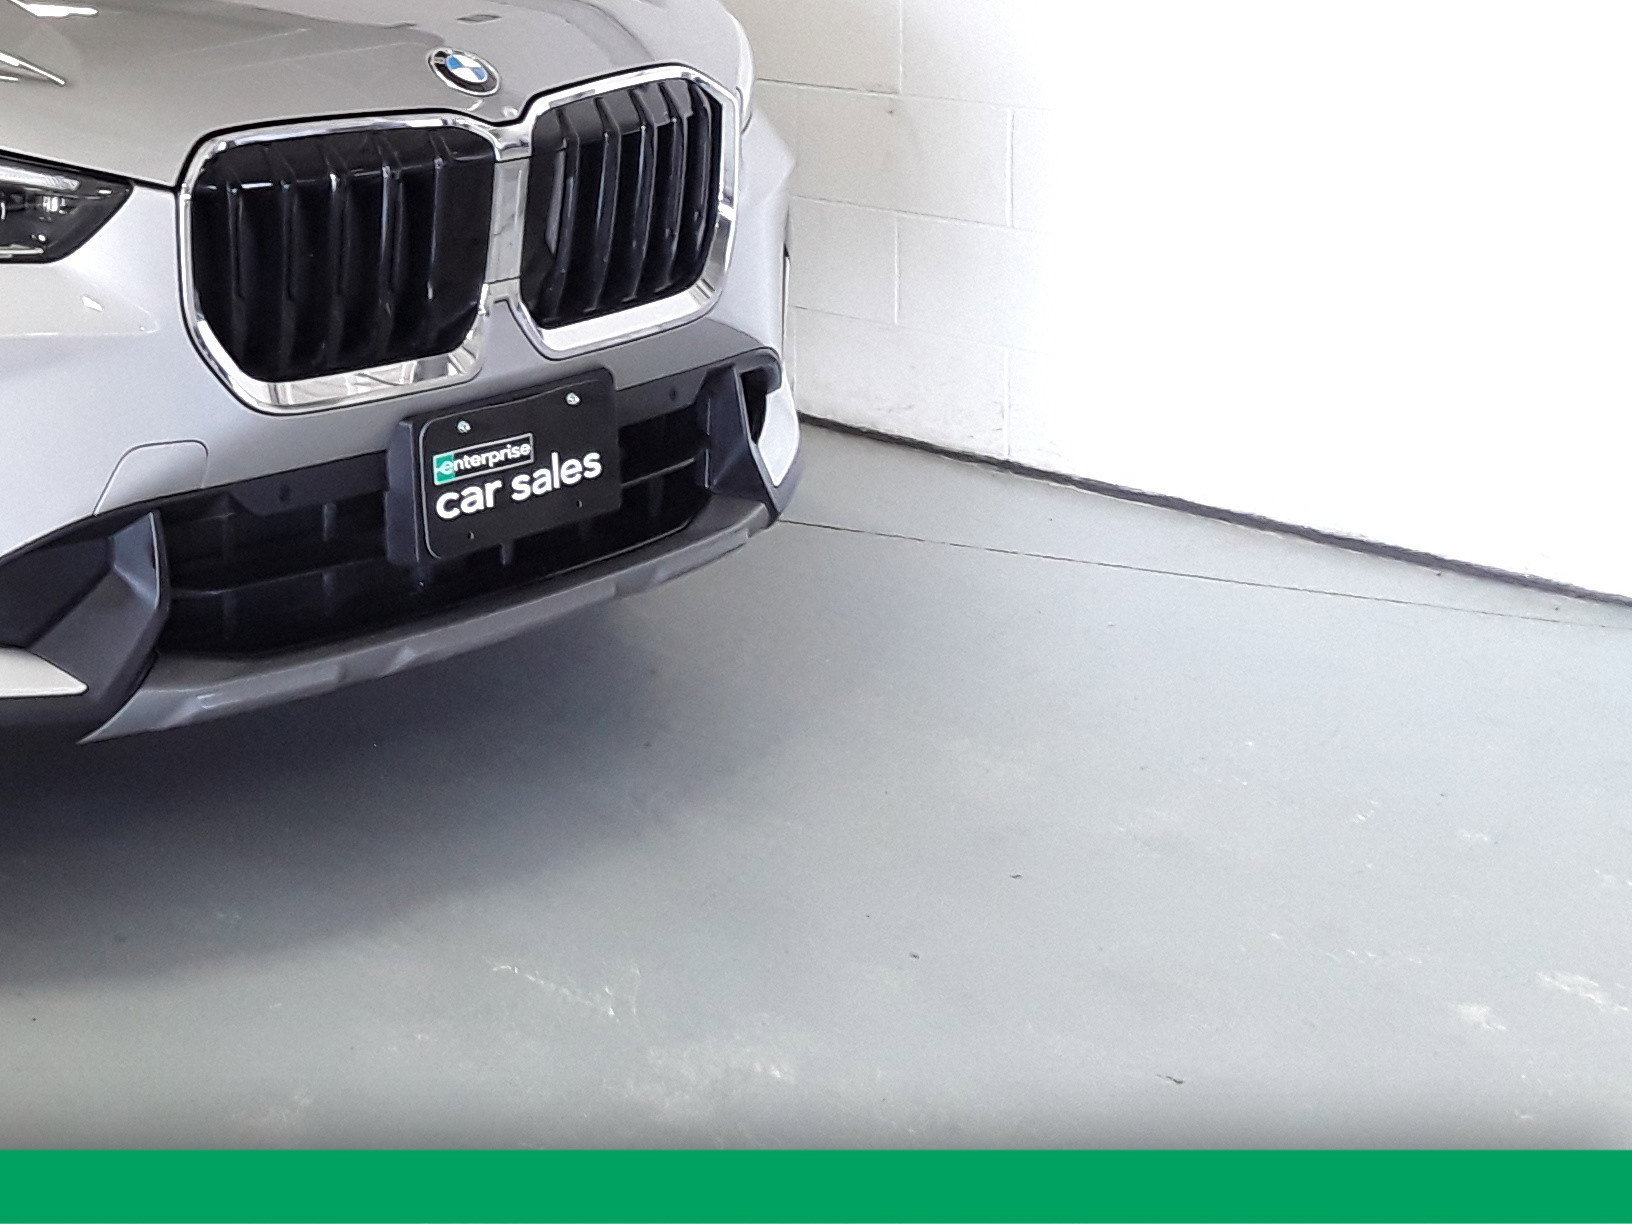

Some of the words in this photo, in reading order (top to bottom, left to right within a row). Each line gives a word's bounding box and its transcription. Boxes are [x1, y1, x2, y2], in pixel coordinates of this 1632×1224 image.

[439, 443, 532, 476] enterprise
[435, 479, 504, 521] car
[511, 452, 602, 501] sales
